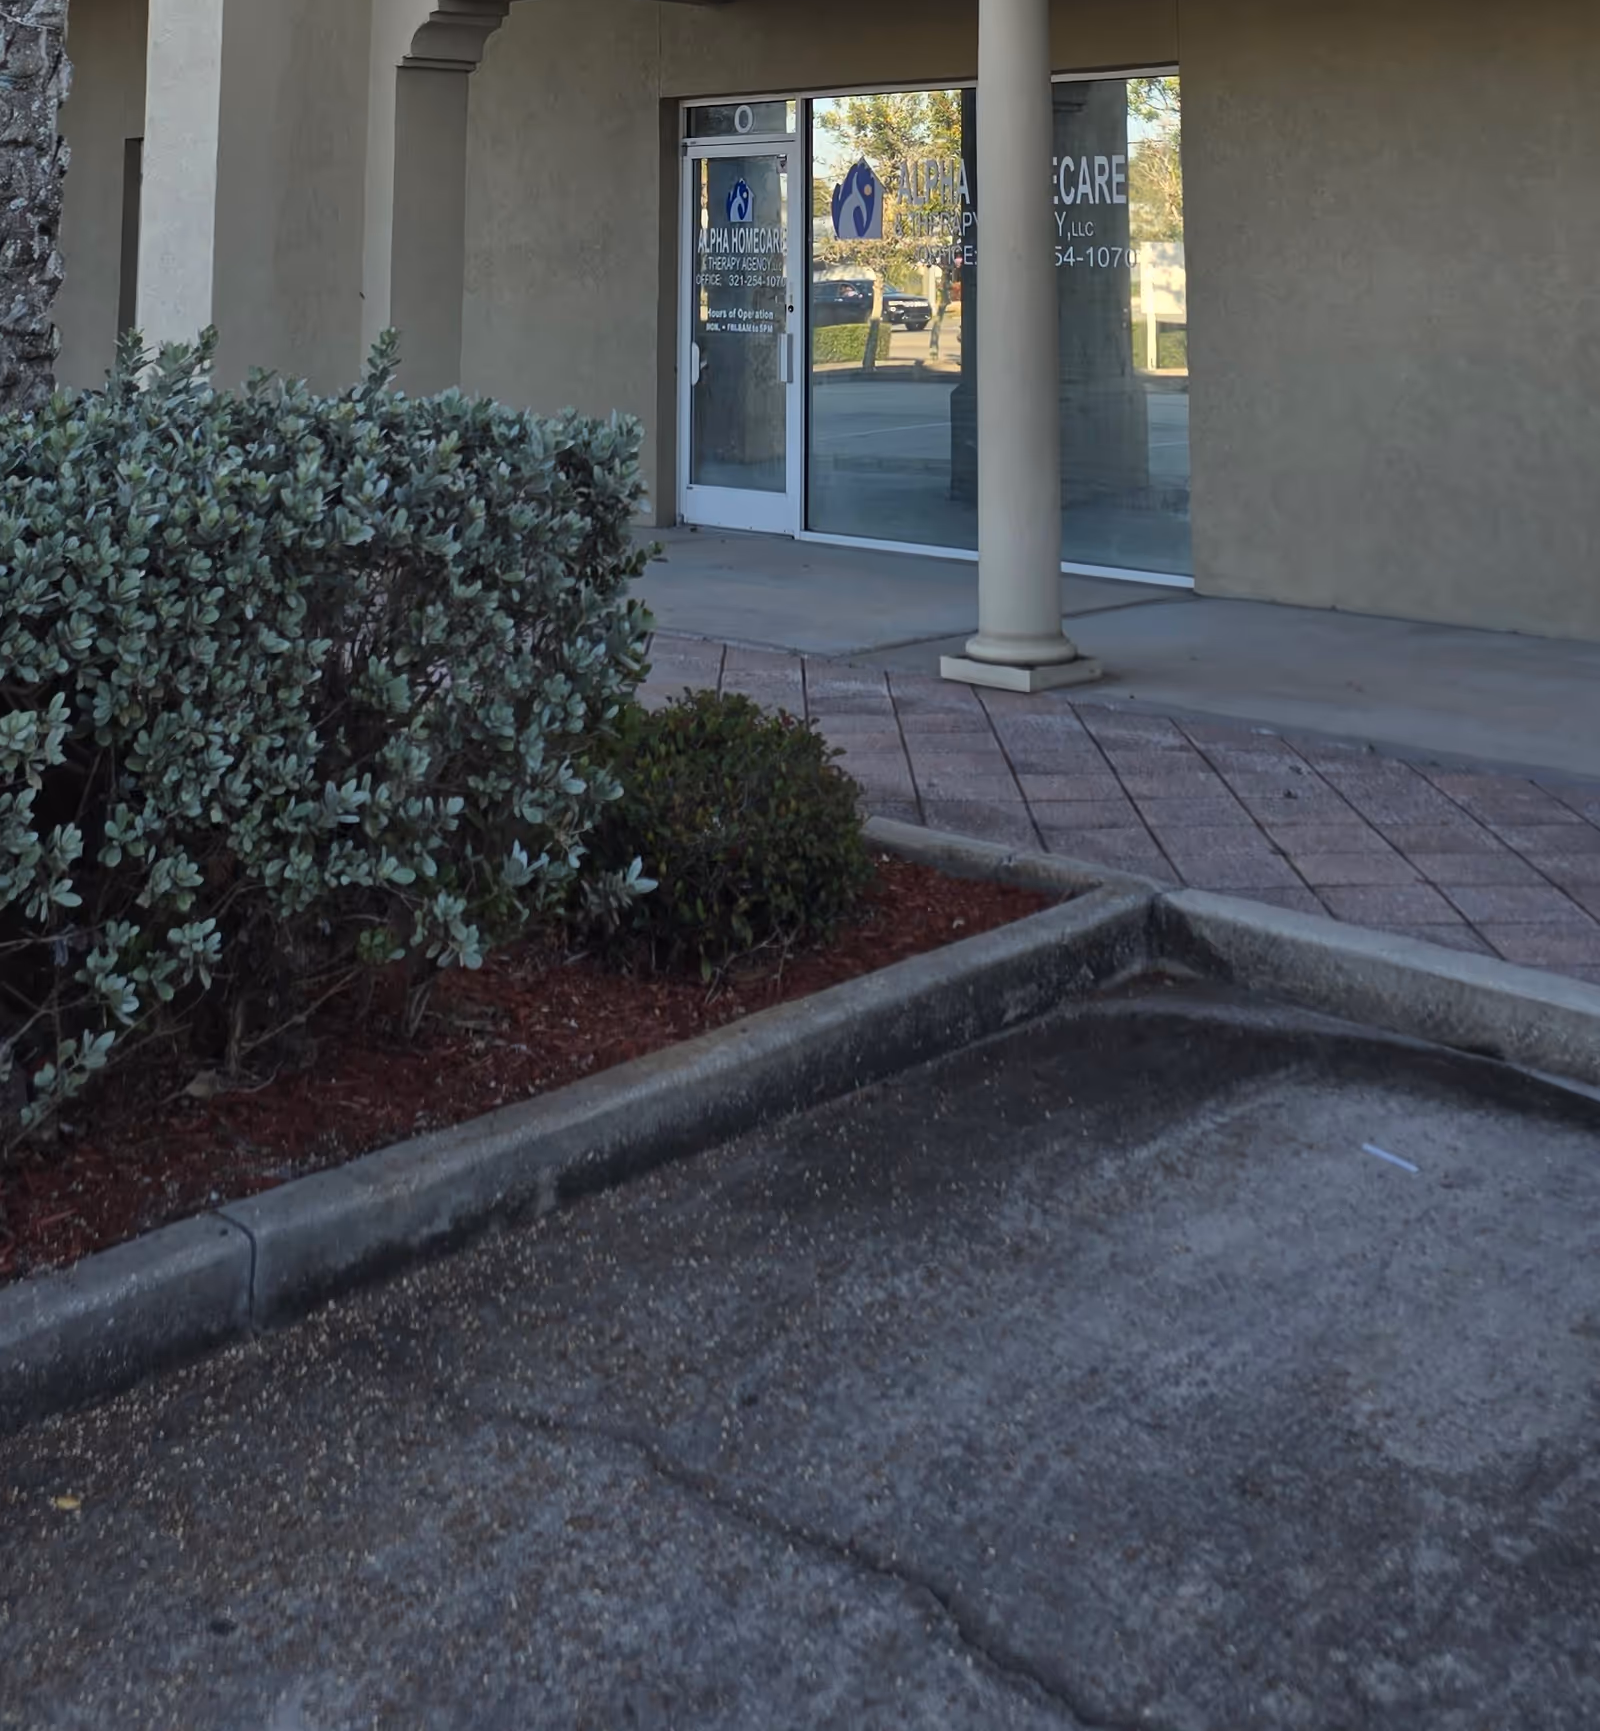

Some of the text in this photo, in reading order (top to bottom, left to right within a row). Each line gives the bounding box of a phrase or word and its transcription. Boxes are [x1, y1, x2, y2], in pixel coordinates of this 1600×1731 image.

[897, 158, 970, 205] ALPHA
[698, 228, 787, 256] ALPHA HOMECARE
[708, 256, 740, 271] THERAPY
[707, 308, 727, 319] Hours
[728, 308, 737, 319] of
